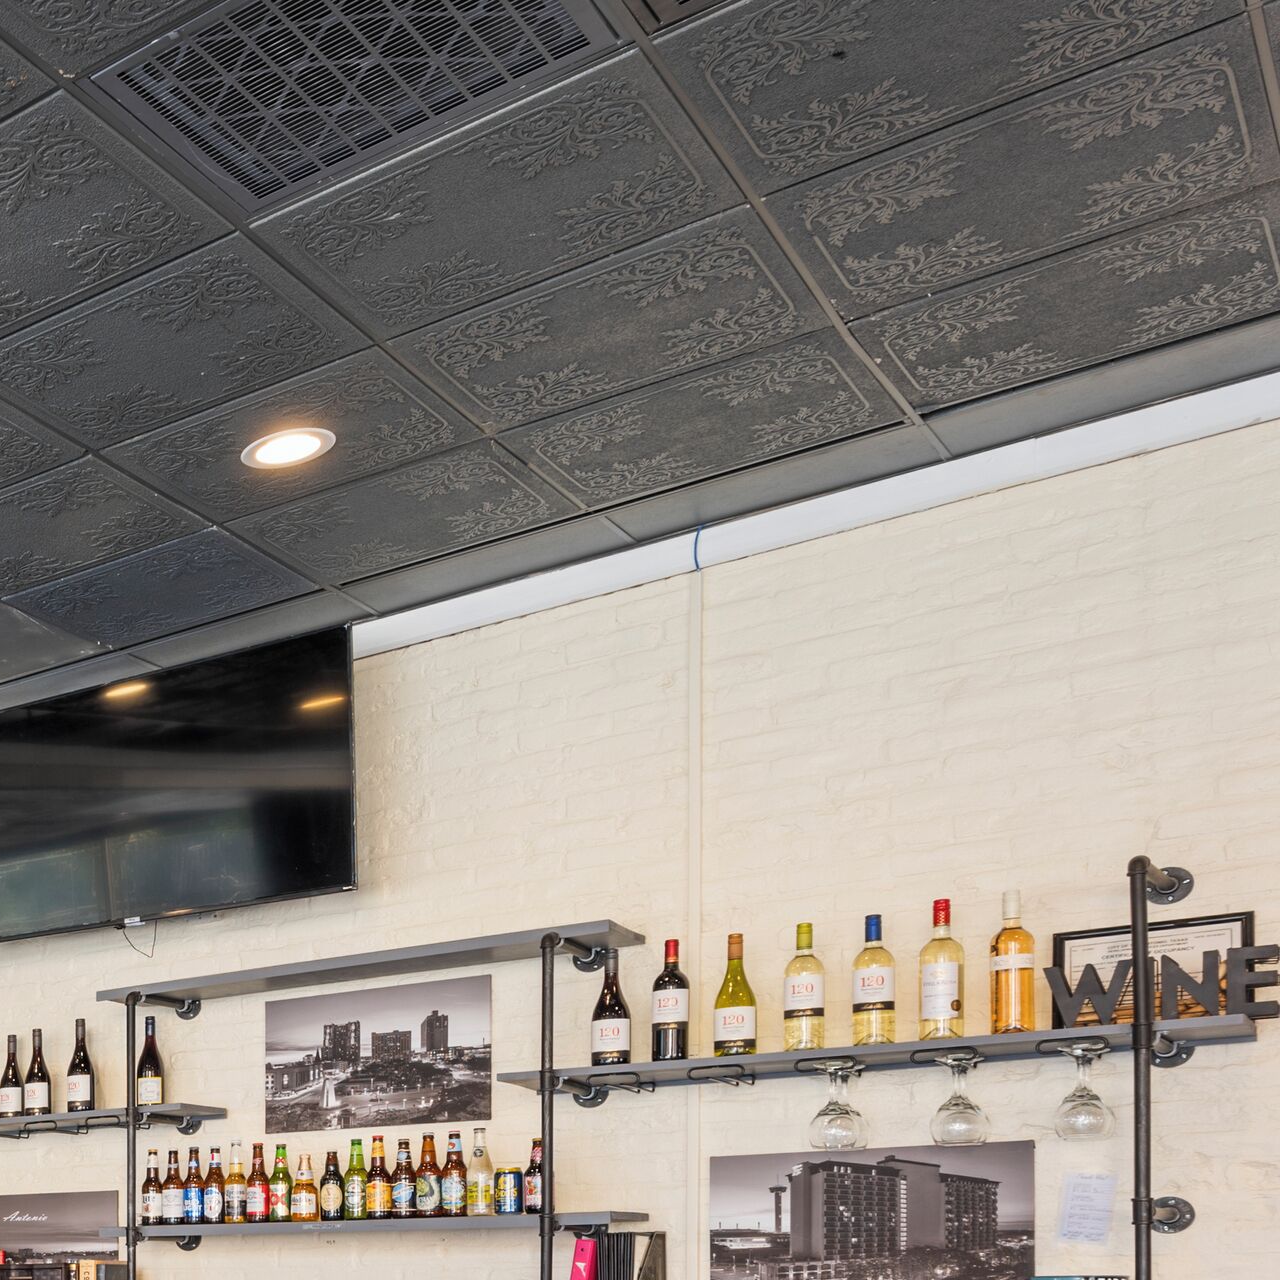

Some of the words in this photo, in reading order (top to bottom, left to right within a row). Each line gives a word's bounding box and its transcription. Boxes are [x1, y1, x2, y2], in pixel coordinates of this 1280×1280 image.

[860, 975, 885, 988] 120
[790, 983, 815, 995] 120
[657, 997, 679, 1009] 120
[722, 1014, 745, 1026] 120
[599, 1027, 620, 1038] 120
[2, 1210, 48, 1222] Antonio
